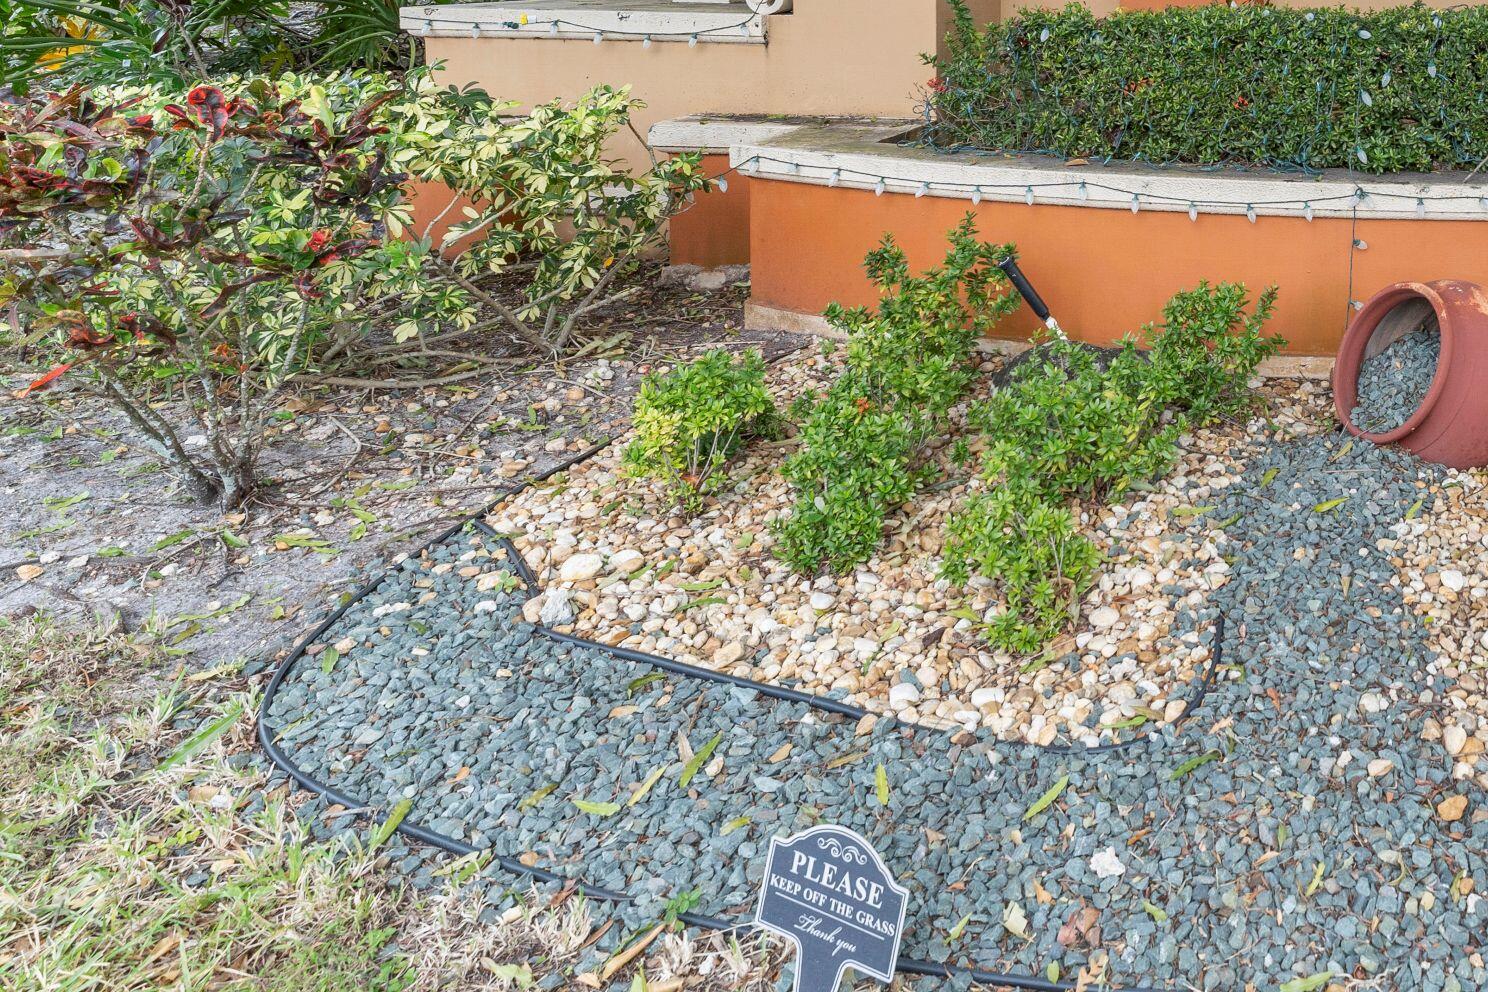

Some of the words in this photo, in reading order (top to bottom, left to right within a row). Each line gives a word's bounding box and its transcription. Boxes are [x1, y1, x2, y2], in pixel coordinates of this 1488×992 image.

[770, 873, 801, 896] KEEP
[803, 887, 827, 907] OFF
[830, 898, 853, 919] THE
[856, 910, 895, 936] GRASS
[790, 850, 884, 908] PLEASE
[793, 913, 843, 943] Thank
[831, 938, 857, 956] you
